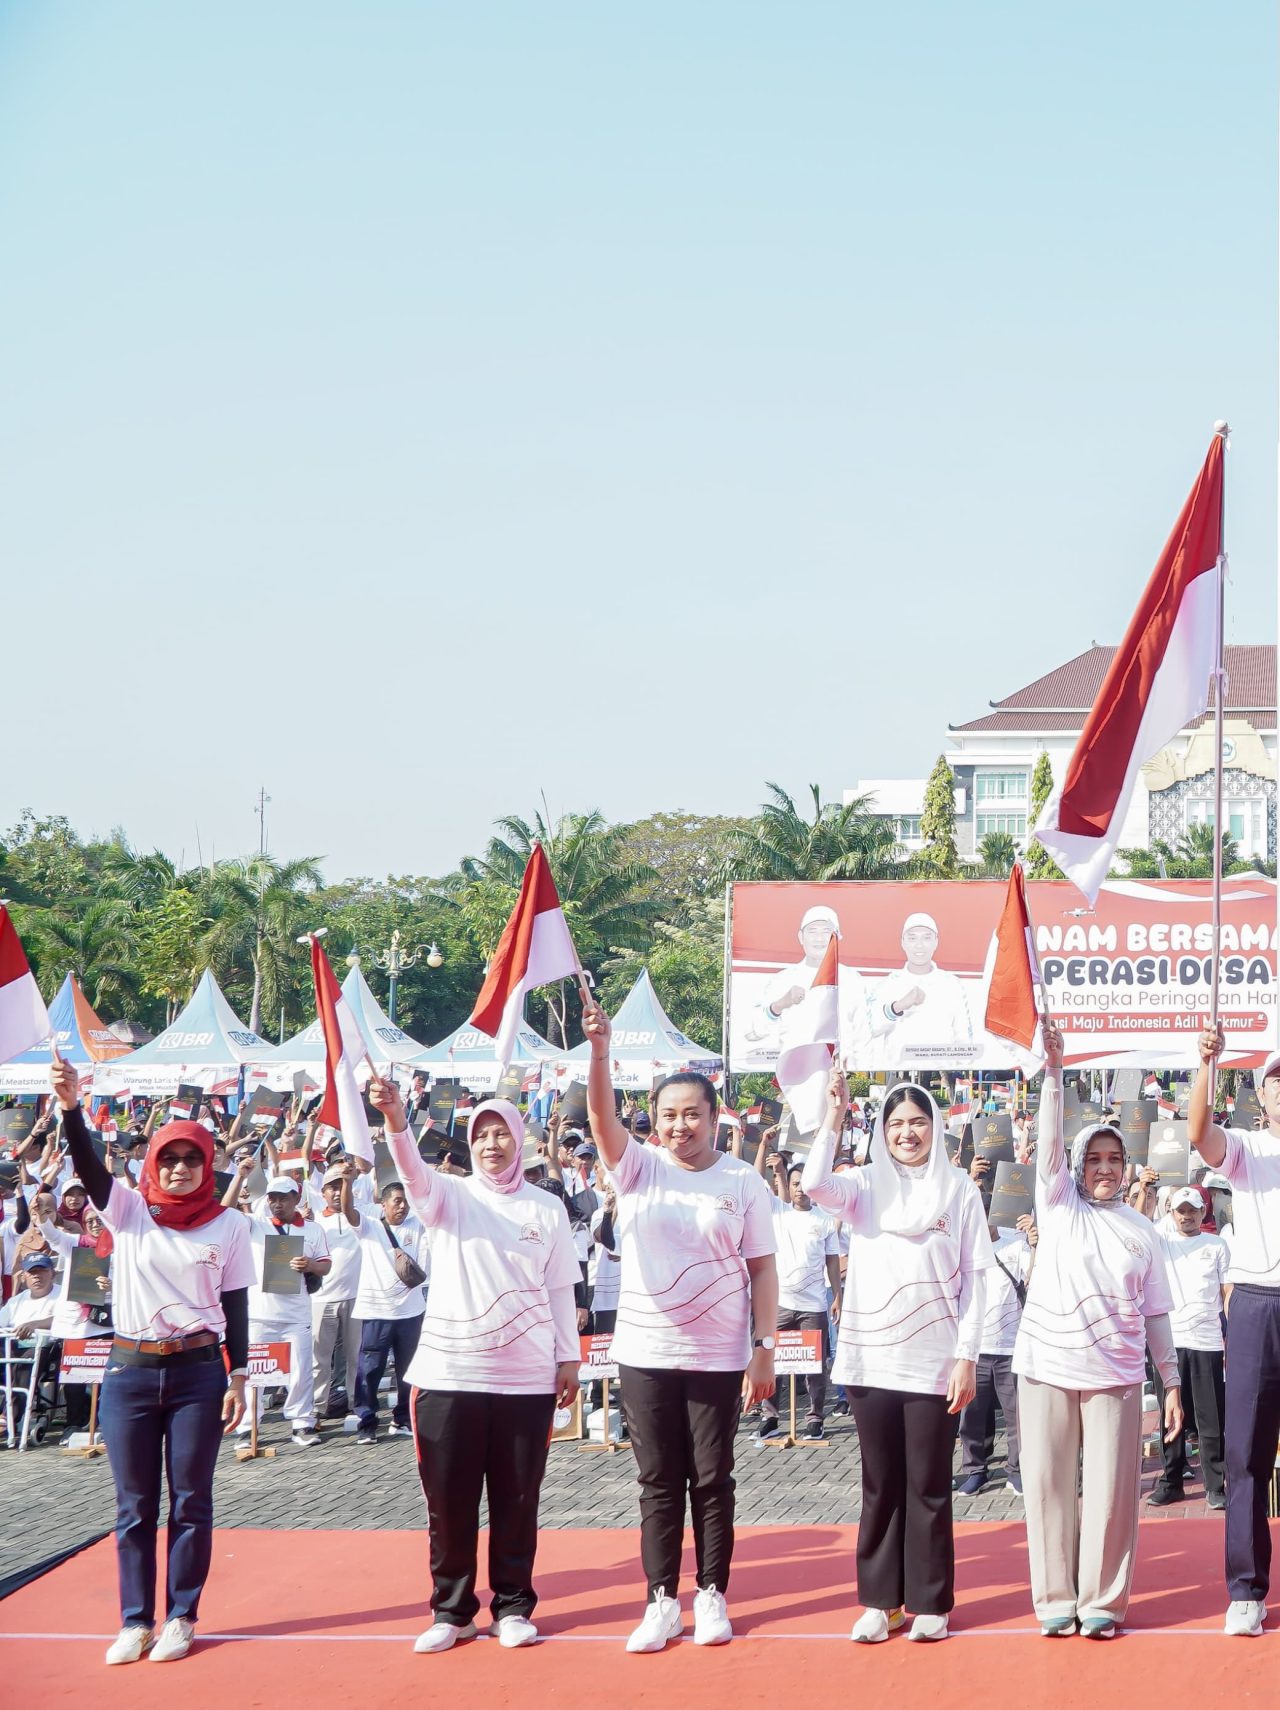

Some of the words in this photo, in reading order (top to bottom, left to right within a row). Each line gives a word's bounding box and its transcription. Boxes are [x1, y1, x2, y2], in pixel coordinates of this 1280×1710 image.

[1036, 924, 1117, 951] NAM
[1044, 958, 1169, 986] PERASI
[1062, 990, 1134, 1010] Rangka
[1139, 990, 1241, 1010] Peringaan
[1072, 1016, 1104, 1031] Maju
[1108, 1015, 1171, 1029] Indonesia
[1174, 1015, 1199, 1028] Adil
[1203, 1015, 1254, 1029] Mkmur
[182, 1032, 215, 1046] BRI
[624, 1032, 656, 1045] BRI
[774, 1345, 816, 1361] KORAME
